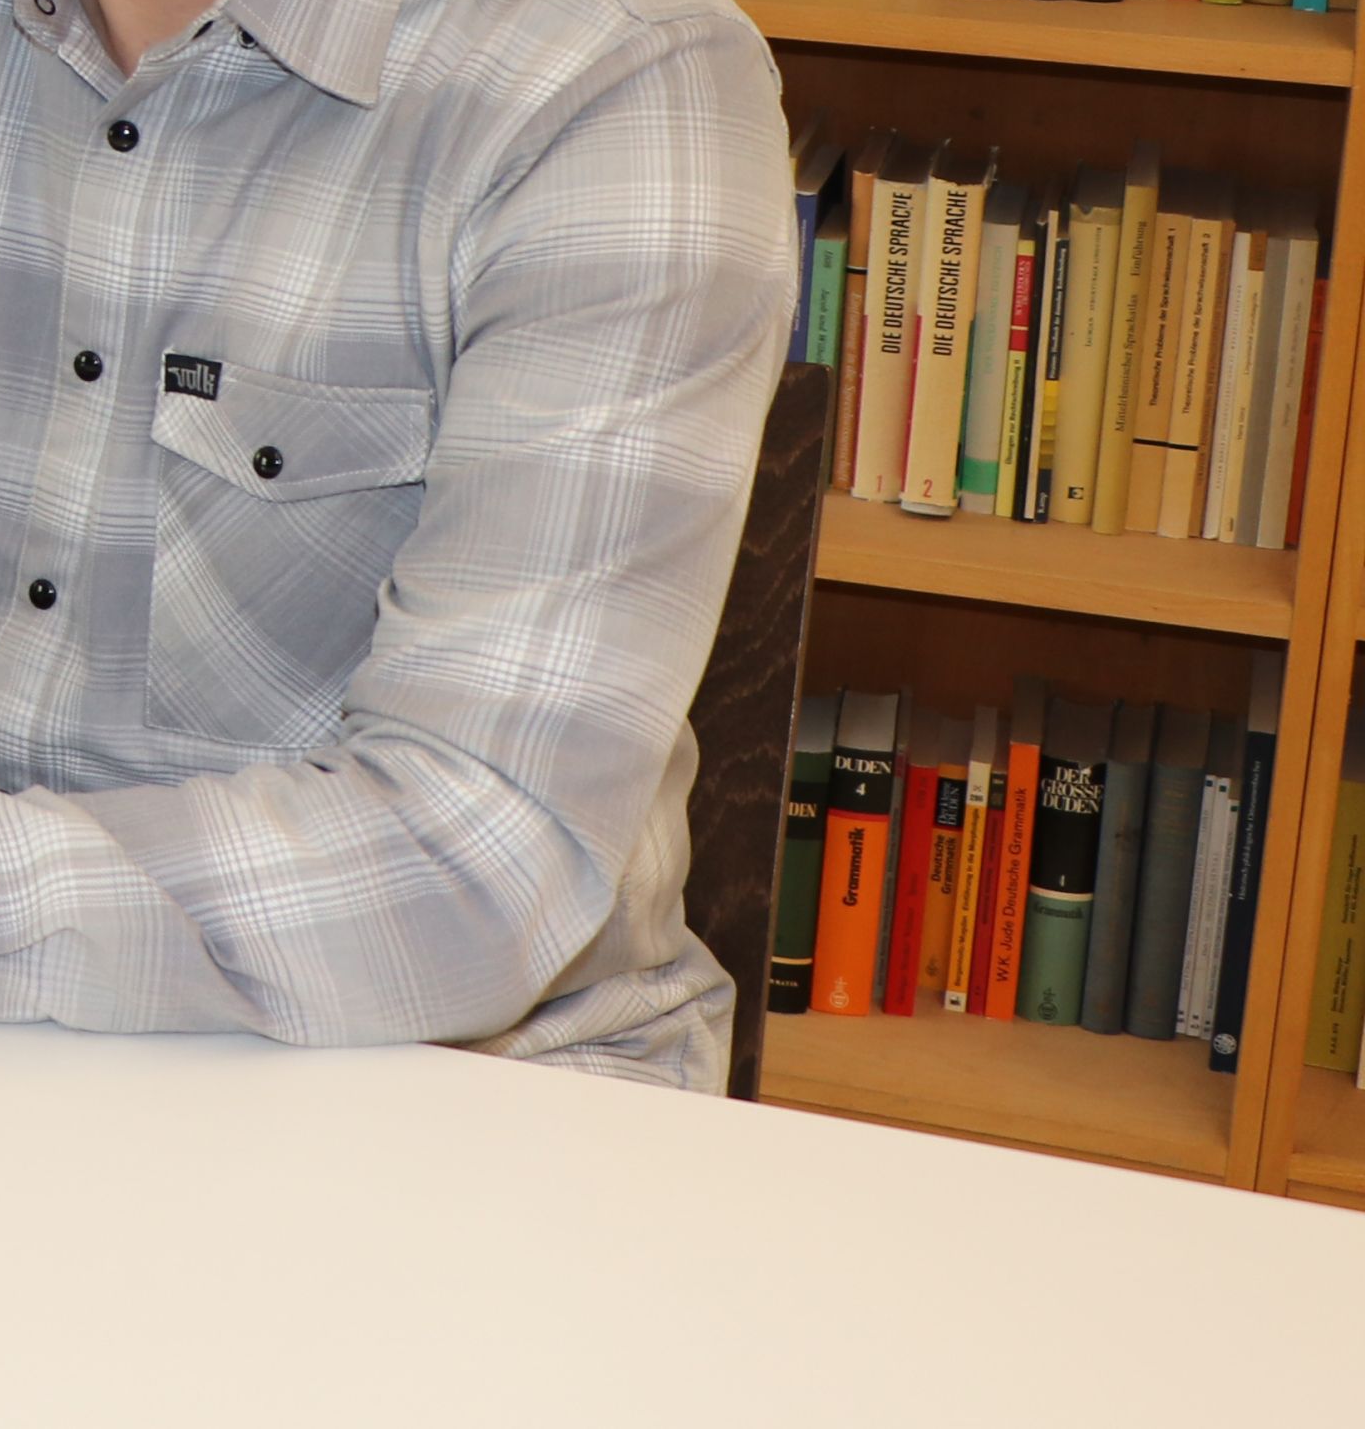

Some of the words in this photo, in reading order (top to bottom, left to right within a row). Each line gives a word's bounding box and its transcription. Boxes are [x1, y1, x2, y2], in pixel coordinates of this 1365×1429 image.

[887, 191, 913, 256] SPRACHE
[942, 189, 968, 256] SPRACHE
[1130, 221, 1147, 277] Einführung
[1159, 235, 1175, 308] Sprachwissenschaft
[882, 260, 908, 328] DEUTSCHE
[934, 260, 961, 330] DEUTSCHE
[1193, 243, 1210, 316] Sprachwissenschaft
[1123, 294, 1139, 350] Sprachatlas
[1157, 310, 1168, 321] der
[880, 332, 902, 354] DIE
[931, 334, 954, 356] DIE
[1154, 324, 1166, 359] Probleme
[1187, 331, 1200, 366] Probleme
[1115, 352, 1134, 433] Mittelrheinischer
[1149, 361, 1163, 406] Theoretische
[1181, 368, 1195, 414] Theoretische
[922, 478, 932, 498] 2
[835, 754, 892, 774] DUDEN
[1055, 765, 1091, 785] DER
[855, 782, 866, 795] 4
[945, 786, 960, 826] DUDEN
[1040, 776, 1104, 800] GROSSE
[1042, 792, 1099, 816] DUDEN
[1007, 786, 1029, 855] Grammatik
[842, 827, 865, 907] Grammatik
[930, 834, 947, 883] Deutsche
[941, 836, 957, 895] Grammatik
[961, 873, 974, 911] Einführung
[1000, 859, 1021, 918] Deutsche
[1000, 922, 1016, 951] Jude
